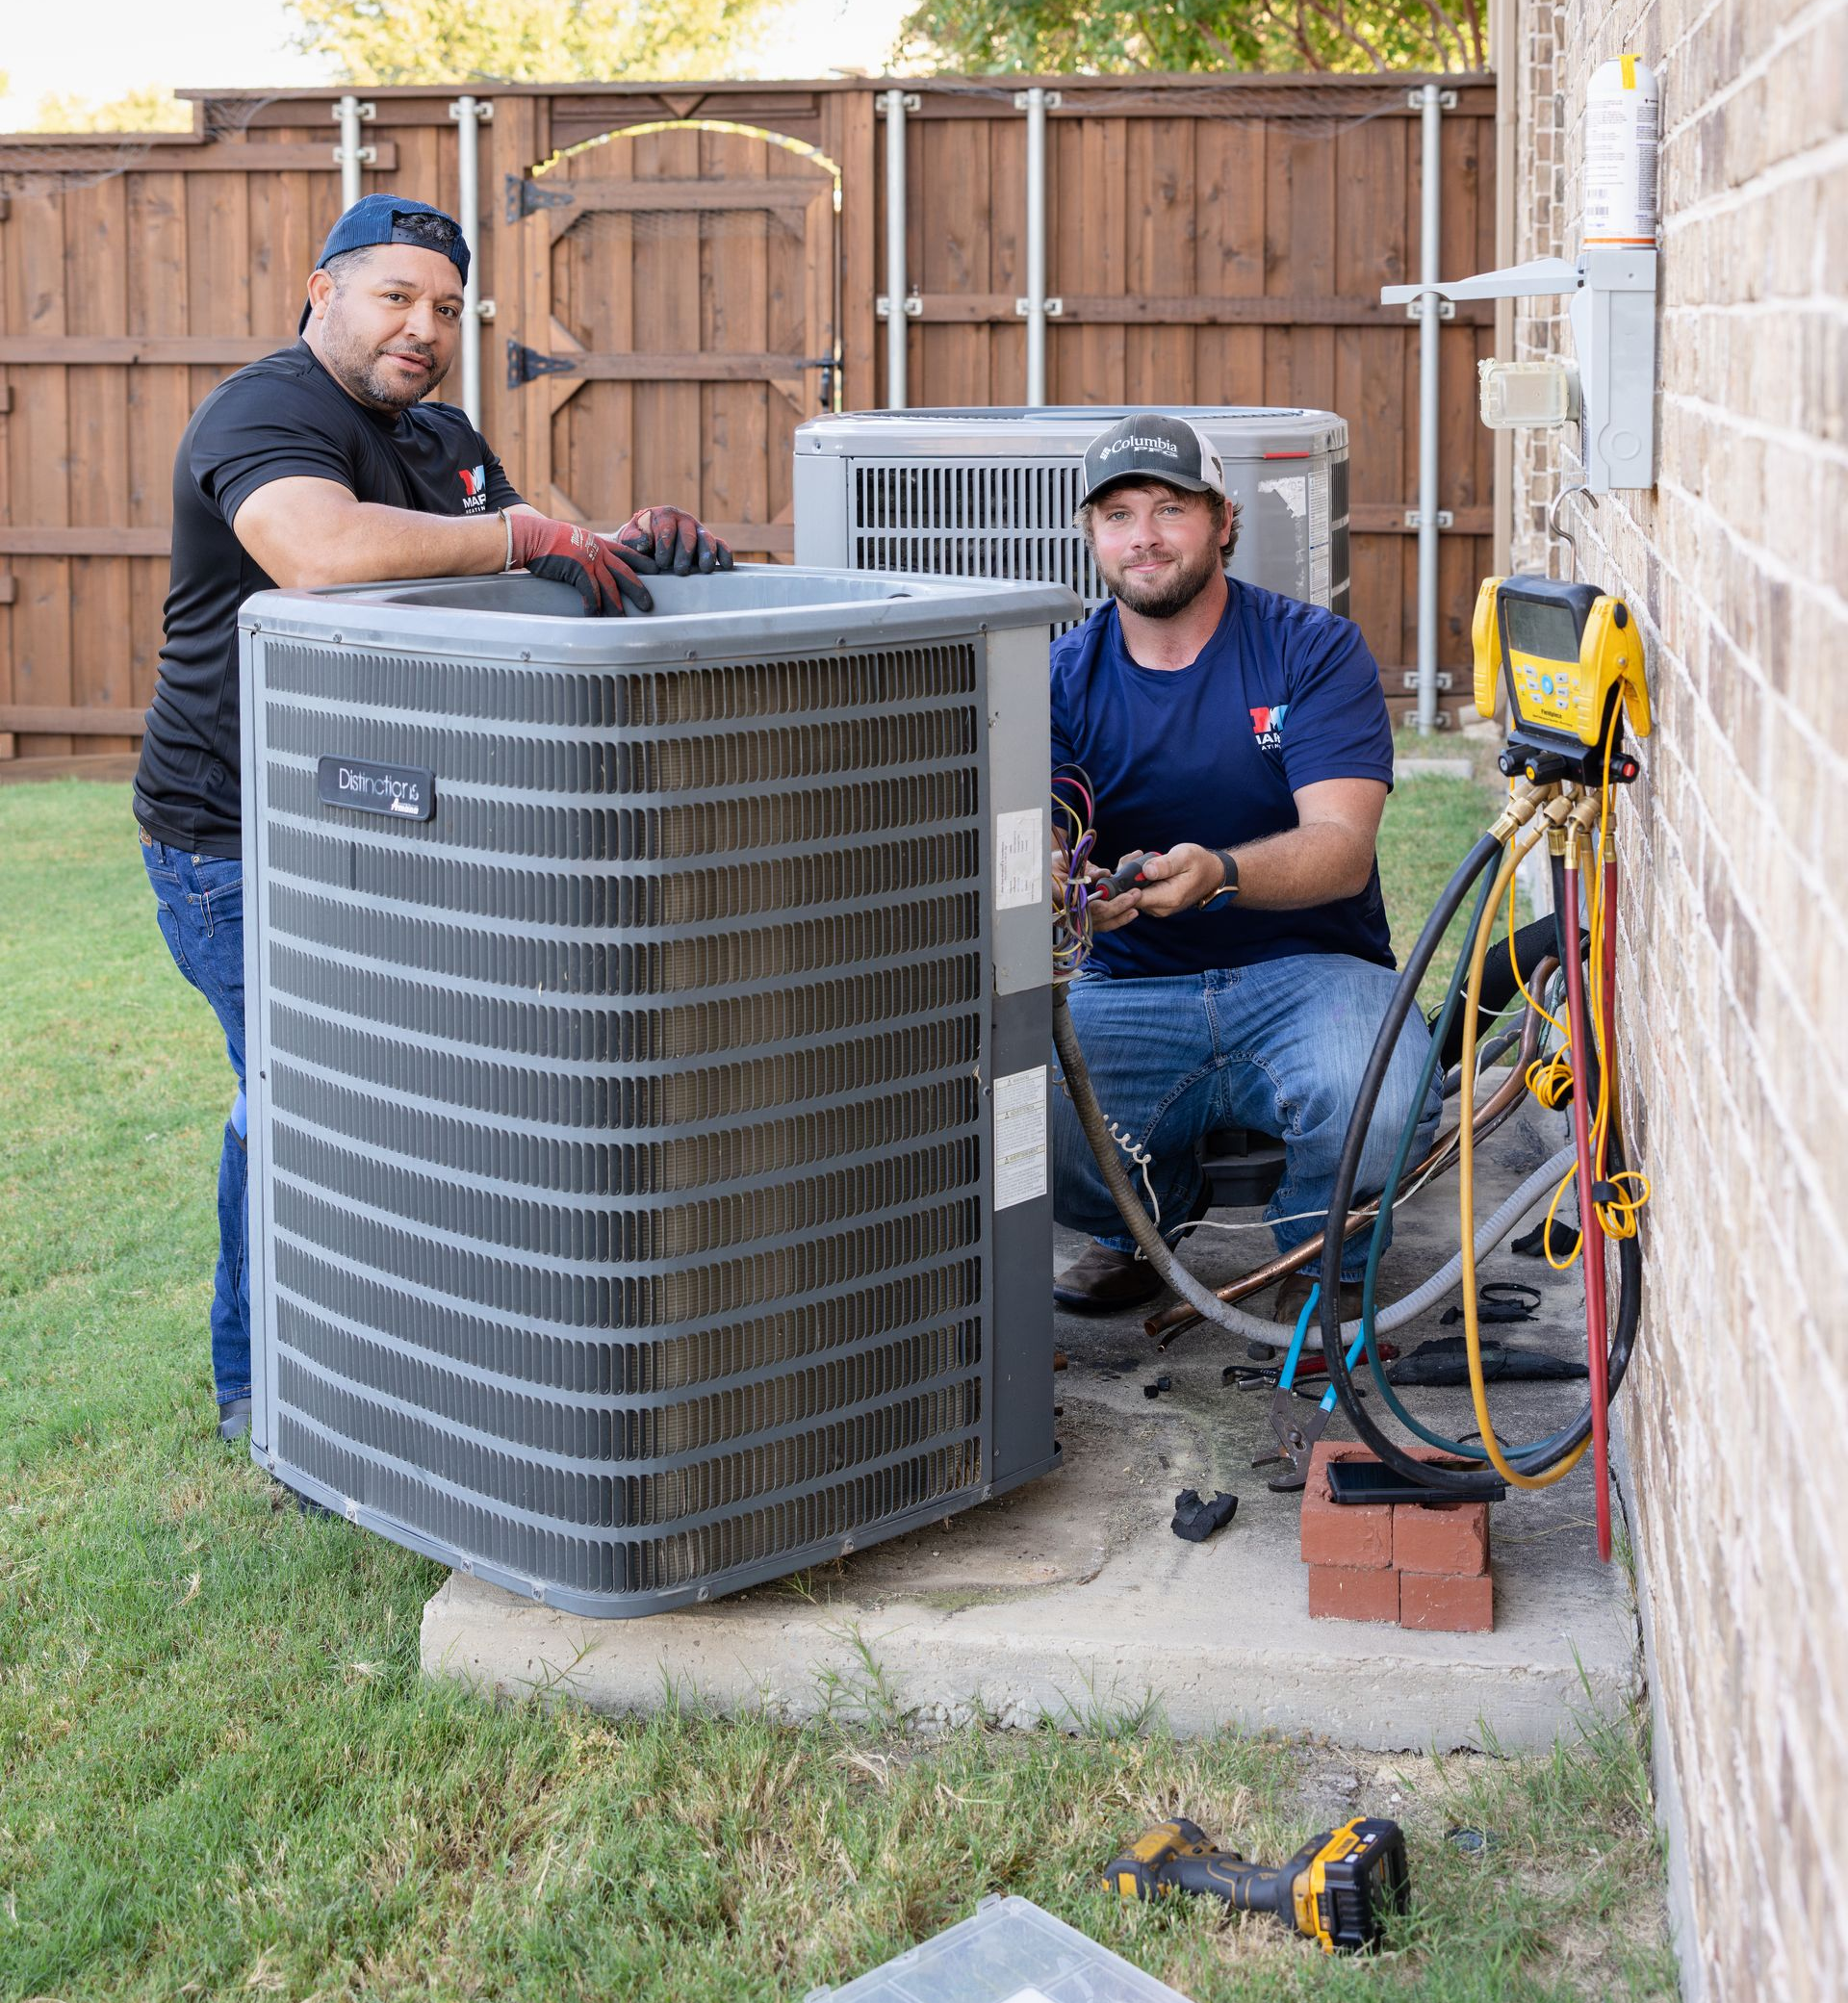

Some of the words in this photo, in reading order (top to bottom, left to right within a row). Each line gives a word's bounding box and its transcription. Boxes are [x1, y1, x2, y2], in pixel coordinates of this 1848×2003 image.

[1111, 435, 1177, 453] Columbia
[1134, 446, 1178, 458] PFG
[339, 767, 420, 801] Distinctions
